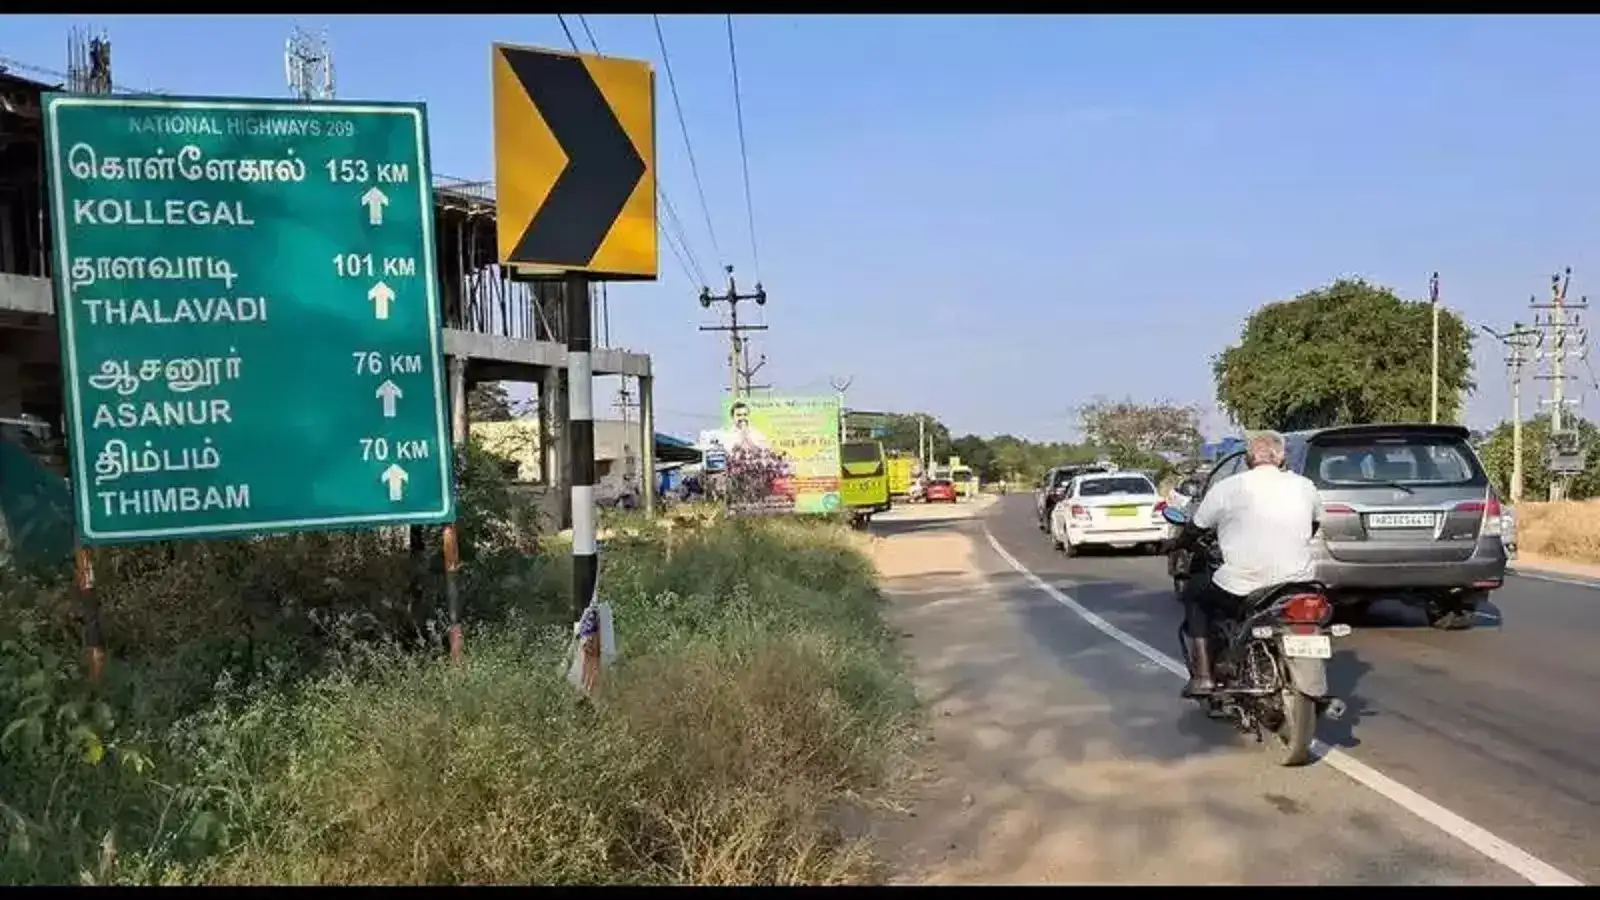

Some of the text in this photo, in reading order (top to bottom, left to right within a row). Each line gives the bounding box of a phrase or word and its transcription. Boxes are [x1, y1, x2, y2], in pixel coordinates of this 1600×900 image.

[128, 115, 355, 137] NATIONAL HIGHWAYS 209
[68, 143, 306, 182] கொள்ளேகால்
[326, 159, 409, 183] 153 KM
[74, 199, 255, 225] KOLLEGAL
[70, 256, 238, 292] தாளவாடி
[333, 253, 415, 277] 101 KM
[82, 297, 267, 324] THALAVADI
[88, 348, 242, 395] ஆசனூர்
[353, 351, 421, 375] 76 KM
[92, 400, 232, 428] ASANUR
[94, 437, 221, 486] திம்பம்
[359, 437, 429, 461] 70 KM
[97, 484, 250, 516] THIMBAM
